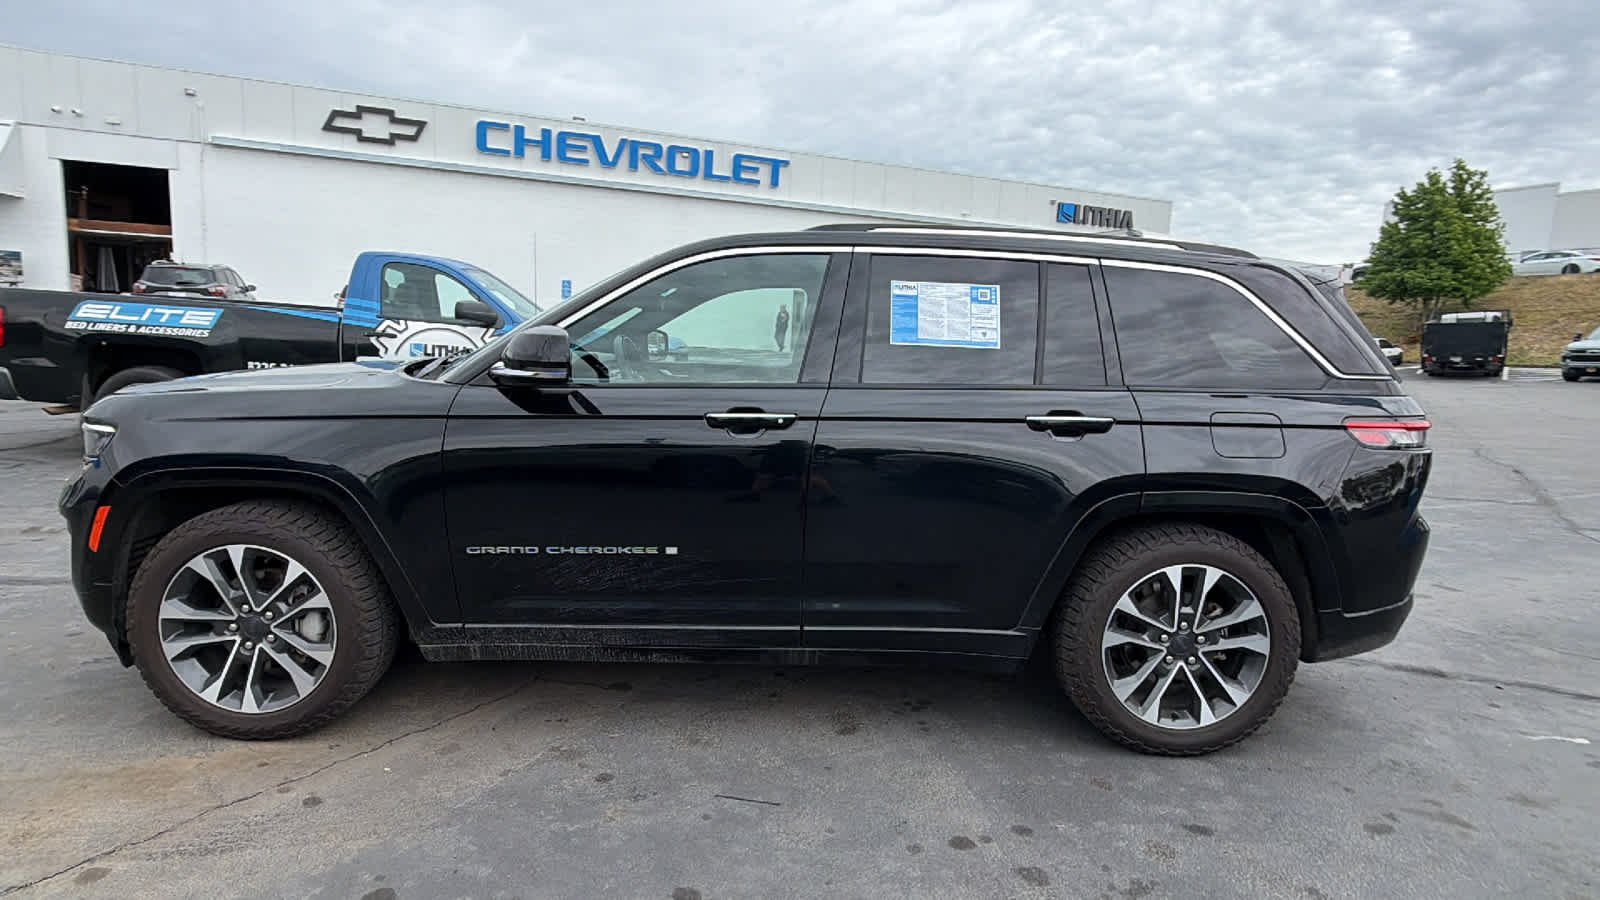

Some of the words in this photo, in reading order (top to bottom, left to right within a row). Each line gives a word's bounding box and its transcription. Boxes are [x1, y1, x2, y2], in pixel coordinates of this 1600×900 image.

[475, 120, 790, 188] CHEVROLET
[1073, 204, 1133, 229] LITHIA
[76, 303, 216, 326] ELITE
[64, 321, 88, 329] BED
[87, 322, 128, 333] LINERS
[128, 324, 137, 333] &
[137, 326, 212, 338] ACCESSORIES
[466, 546, 539, 555] GRAND
[546, 546, 659, 555] CHEROKEE
